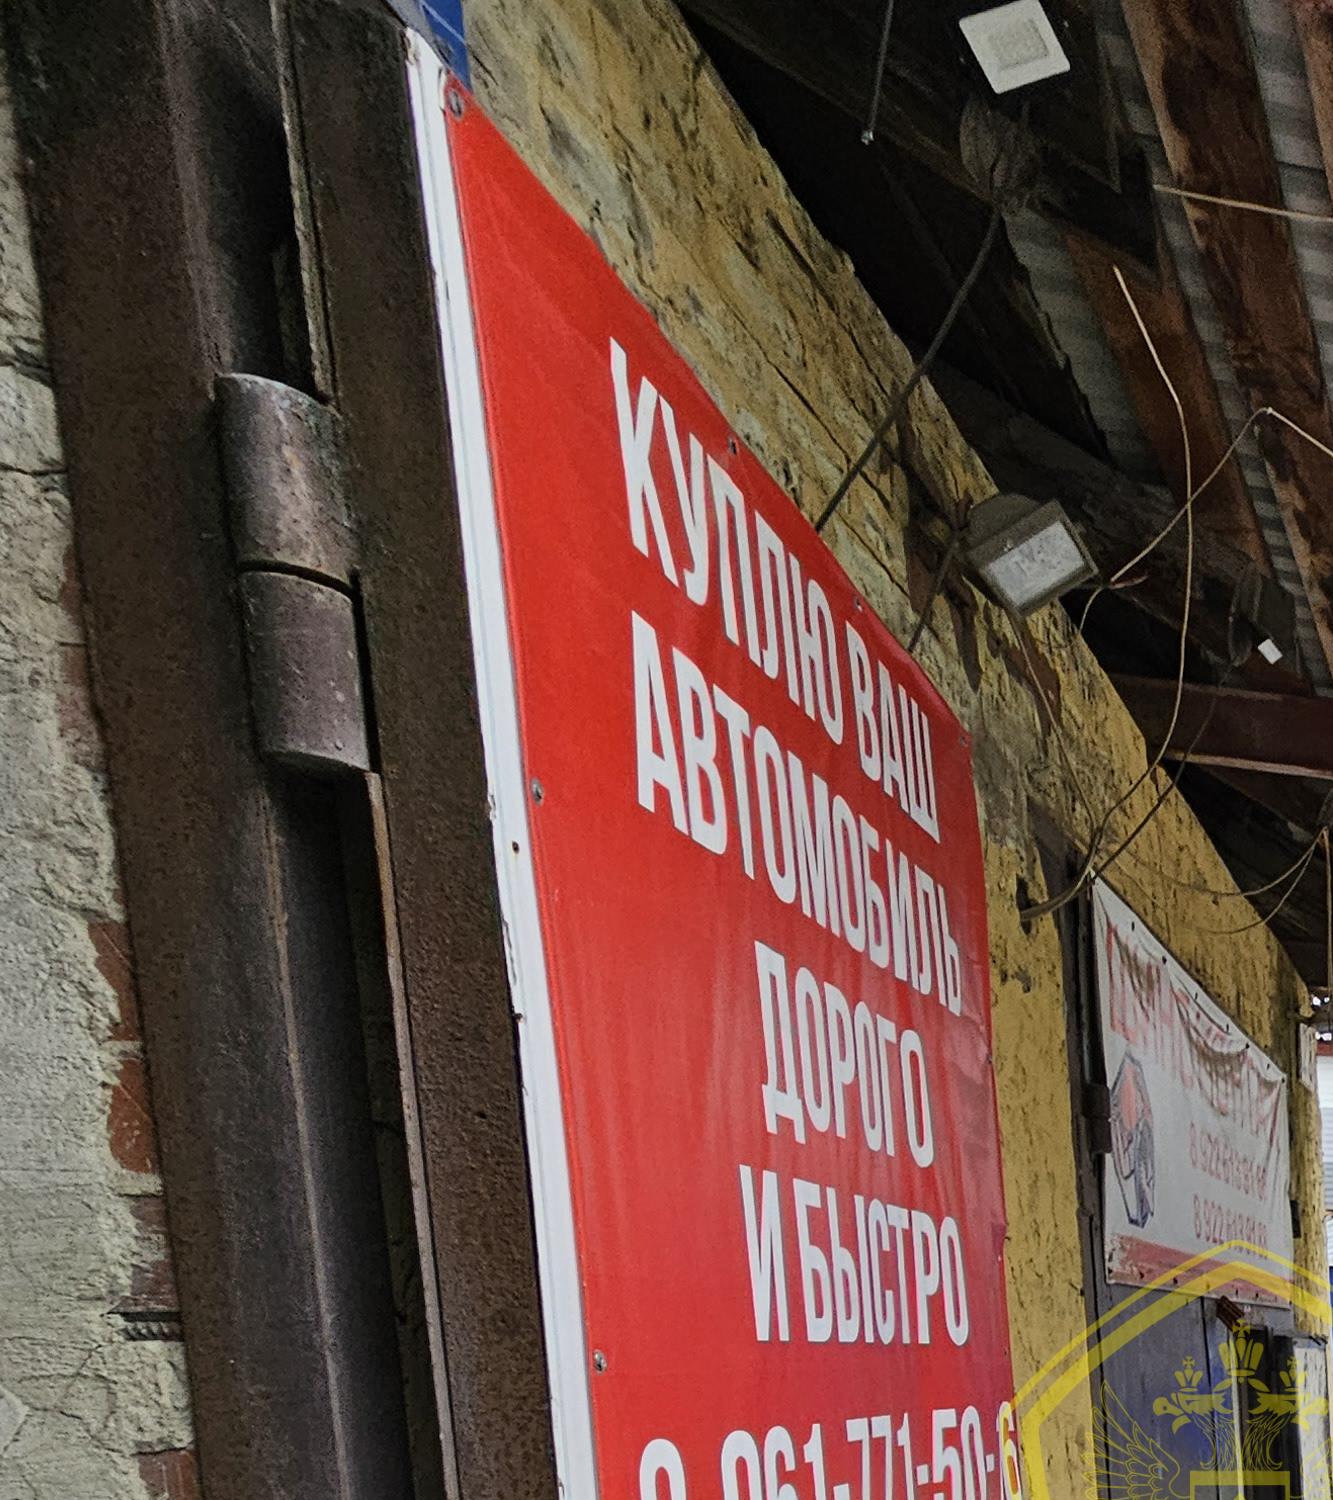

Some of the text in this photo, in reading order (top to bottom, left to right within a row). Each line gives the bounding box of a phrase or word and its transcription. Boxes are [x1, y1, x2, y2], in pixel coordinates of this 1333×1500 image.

[610, 337, 940, 843] КУПЛЮ ВАШ
[631, 610, 961, 1016] АВТОМОБИЛЬ
[754, 941, 934, 1167] ДОРОГО
[739, 1165, 968, 1346] И БЫСТРО
